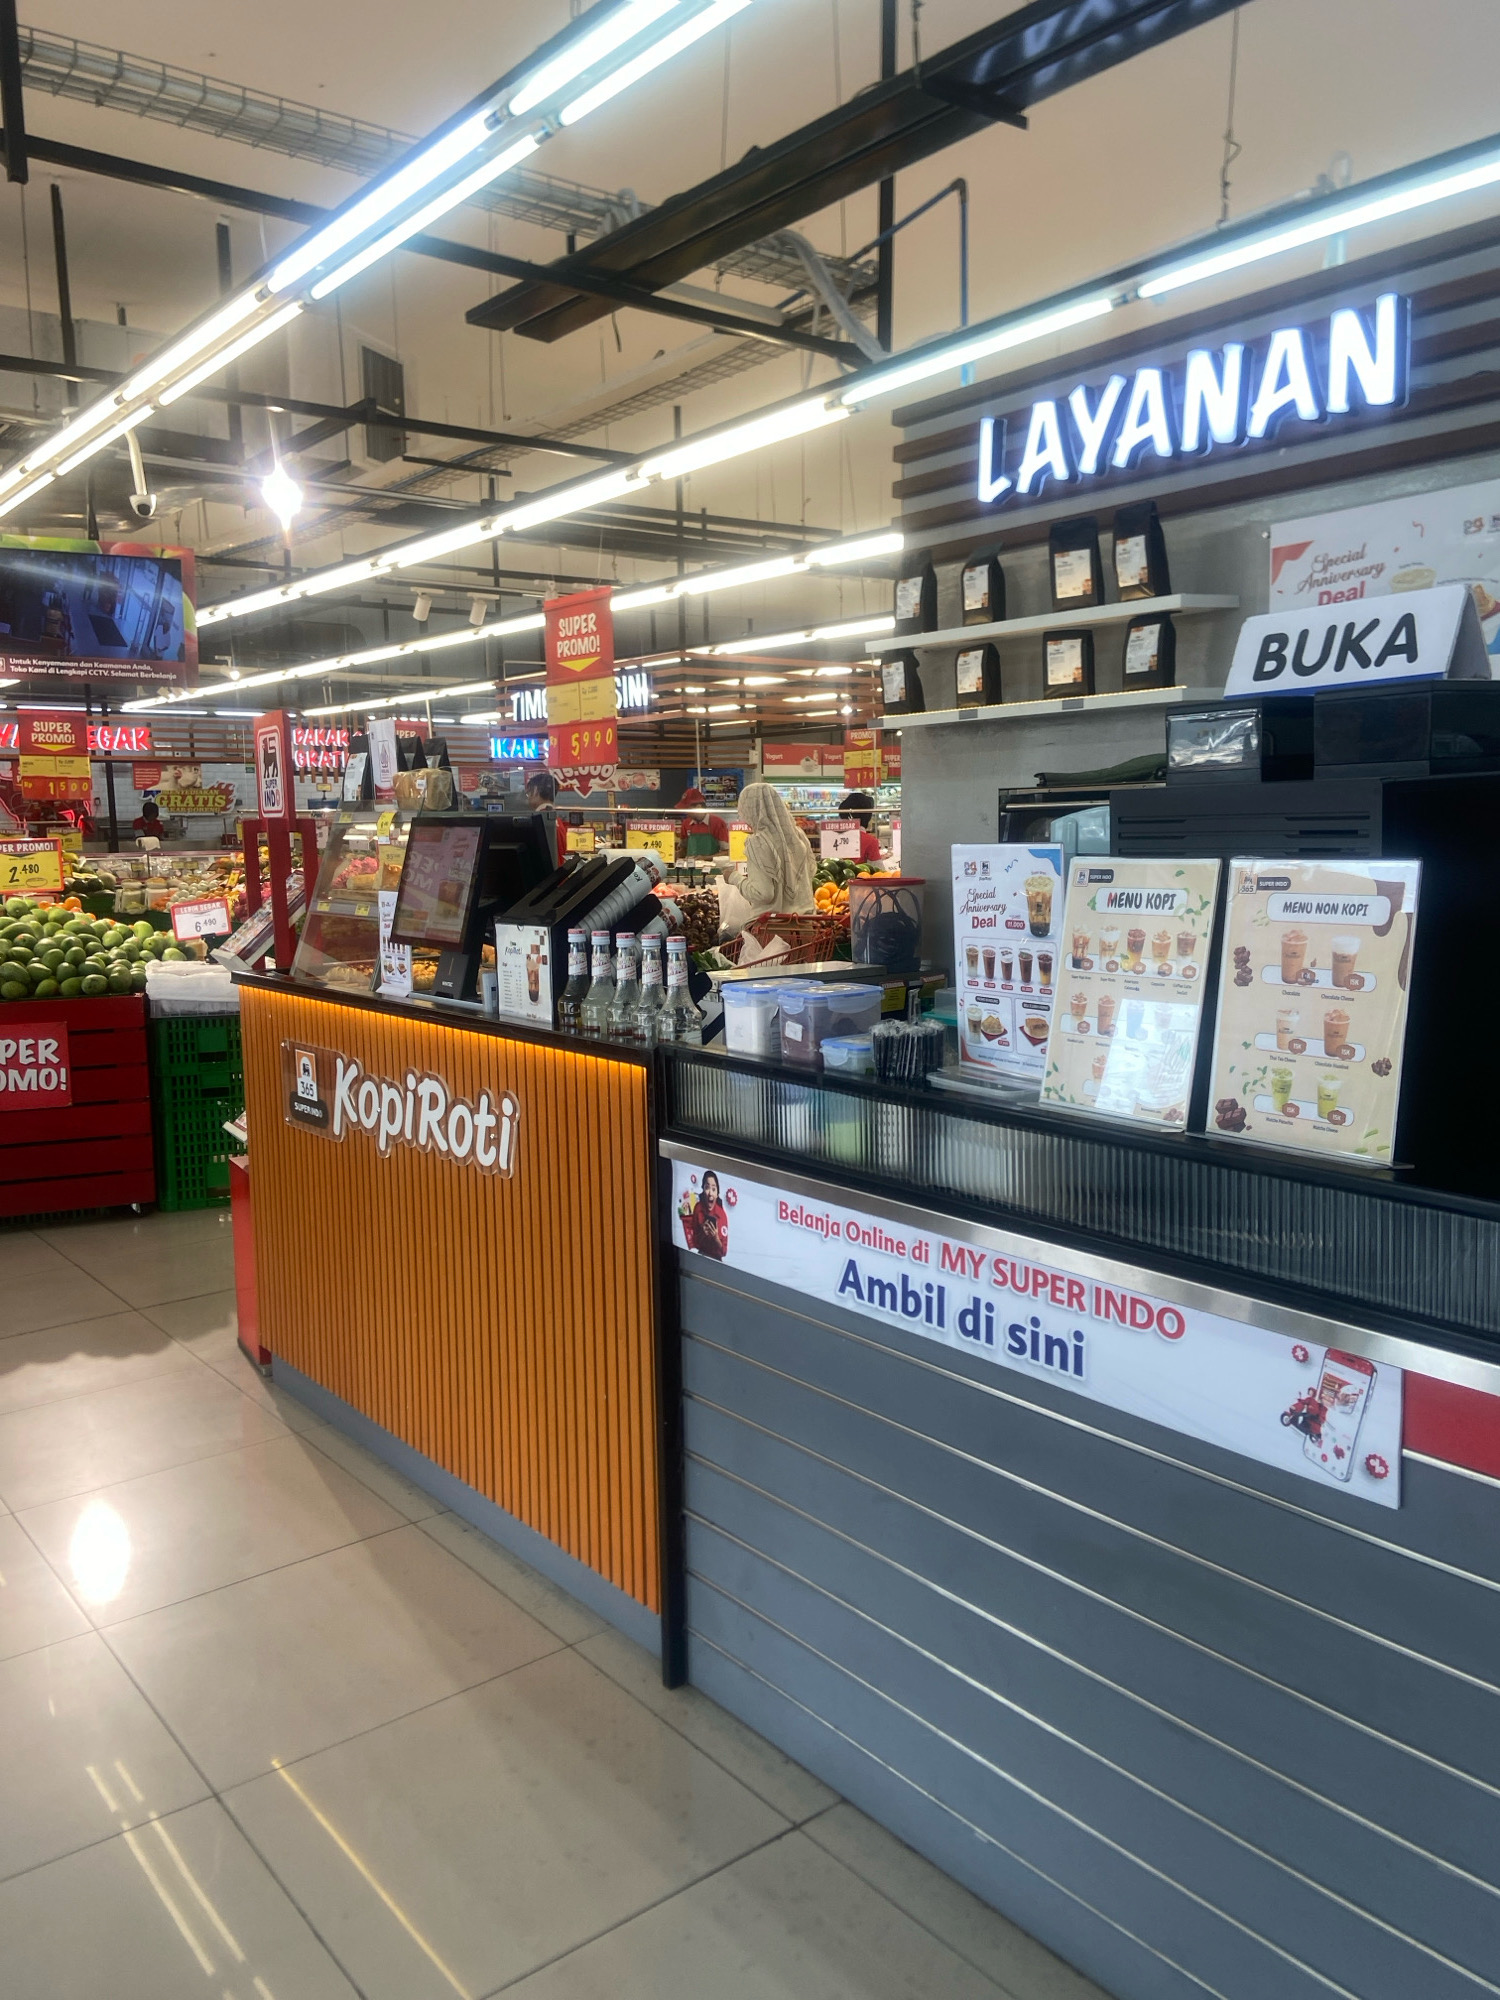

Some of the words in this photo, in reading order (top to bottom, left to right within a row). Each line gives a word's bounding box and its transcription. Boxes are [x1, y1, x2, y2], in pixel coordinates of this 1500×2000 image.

[976, 292, 1405, 502] LAYANAN
[1311, 543, 1367, 574] Special
[1294, 562, 1385, 595] Anniversary
[1318, 581, 1366, 606] Deal
[558, 613, 597, 637] SUPER
[557, 635, 600, 658] PROMO!
[1252, 612, 1418, 682] BUKA
[10, 658, 31, 666] Untuk
[32, 658, 79, 669] Kenyamanan
[80, 660, 93, 668] dan
[94, 662, 132, 670] Keamanan
[31, 666, 48, 674] Kami
[56, 667, 88, 677] Lengkapi
[110, 670, 140, 679] Selamat
[140, 670, 177, 680] Berbelanja
[33, 721, 72, 732] SUPER
[31, 732, 76, 744] PROMO!
[293, 728, 350, 747] BAKAR
[490, 737, 539, 759] IKAN
[265, 779, 278, 789] SUPER
[155, 795, 226, 808] GRATIS
[264, 791, 281, 808] INDO
[648, 823, 672, 832] PROMO!
[16, 842, 54, 852] PROMO!
[9, 864, 40, 884] 2.480
[967, 886, 996, 904] Special
[1107, 892, 1143, 910] MENU
[1146, 892, 1177, 911] KOPI
[180, 906, 199, 914] LEBIH
[199, 903, 222, 911] SEGAR
[959, 900, 1008, 916] Anniversary
[1282, 901, 1312, 914] MENU
[1315, 902, 1340, 915] NON
[1342, 904, 1368, 917] KOPI
[972, 914, 996, 930] Deal
[300, 1080, 314, 1097] 365
[333, 1057, 514, 1171] KopiRoti
[778, 1199, 841, 1240] Belanja
[845, 1220, 907, 1257] Online
[912, 1240, 930, 1265] di
[940, 1242, 988, 1280] MY
[993, 1258, 1086, 1312] SUPER
[1094, 1286, 1185, 1340] INDO
[838, 1258, 945, 1329] Ambil
[957, 1296, 995, 1346] di
[1007, 1316, 1085, 1378] sini
